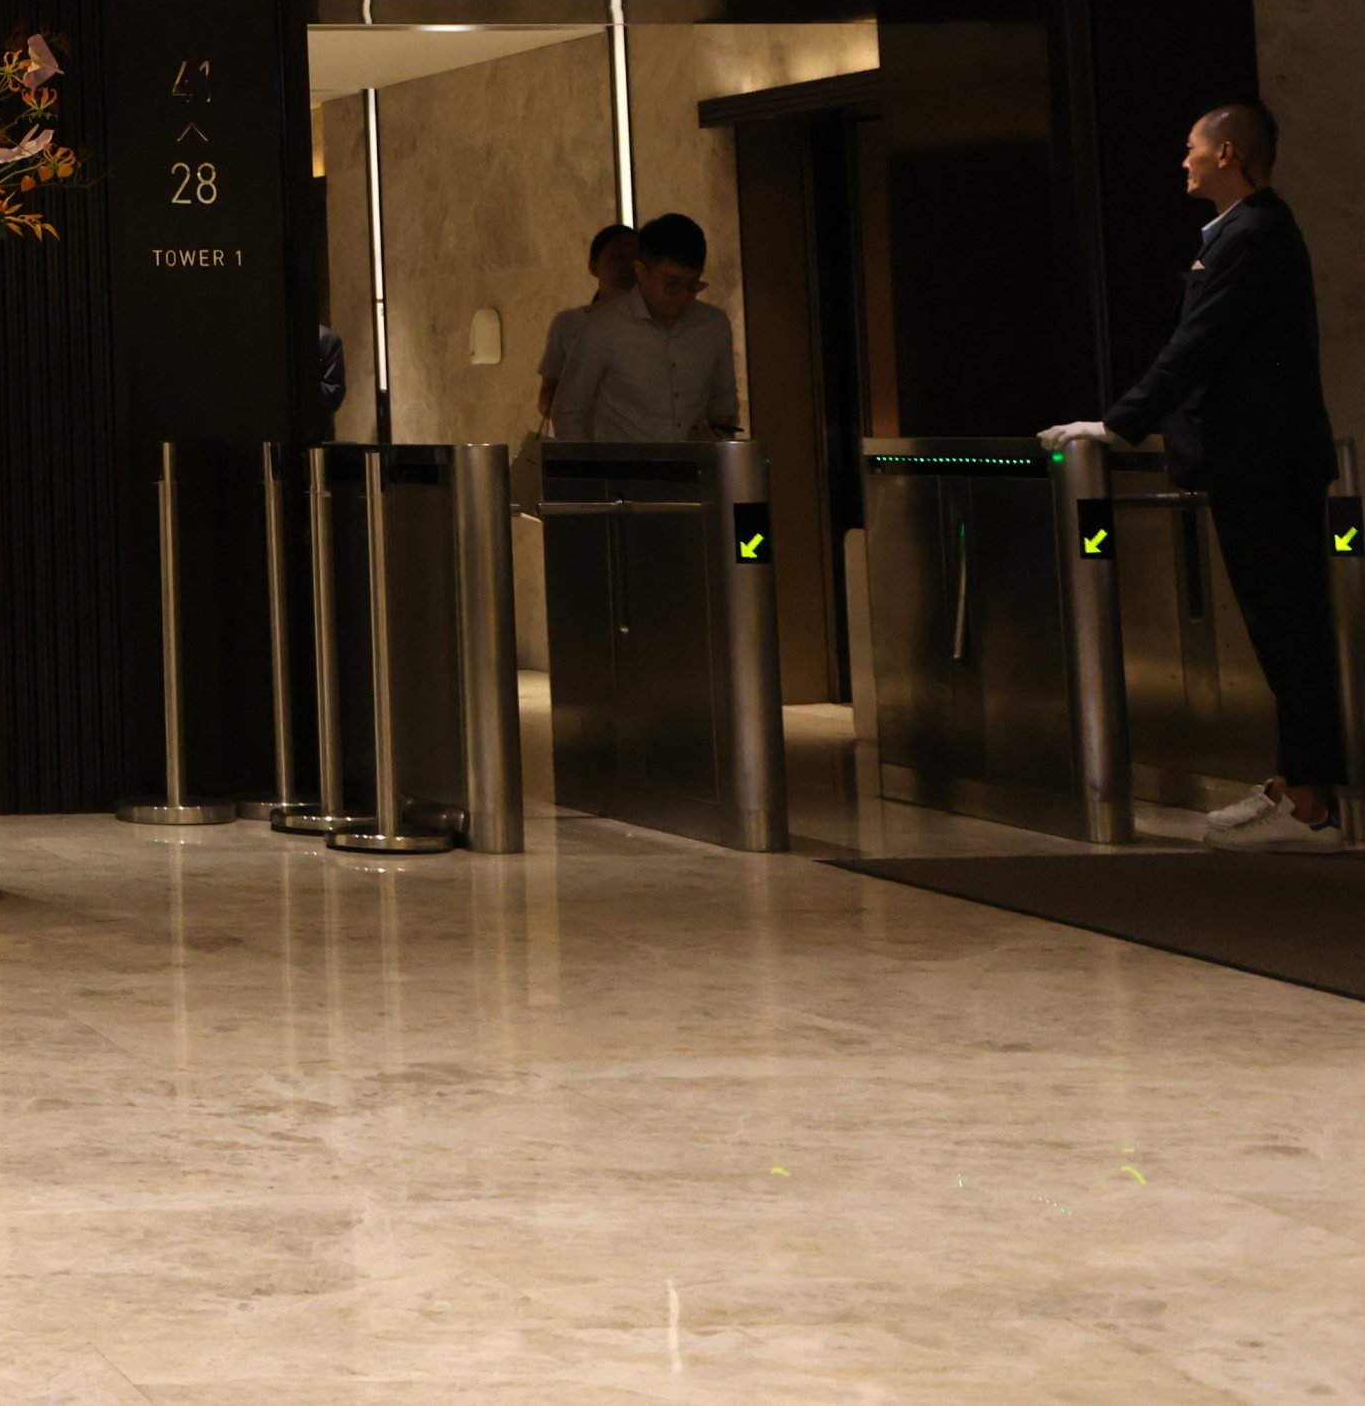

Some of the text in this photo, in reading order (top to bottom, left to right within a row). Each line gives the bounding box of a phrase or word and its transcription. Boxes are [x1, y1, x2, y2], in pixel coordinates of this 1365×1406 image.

[171, 60, 211, 103] 41
[170, 161, 217, 205] 28
[152, 249, 243, 267] TOWER 1
